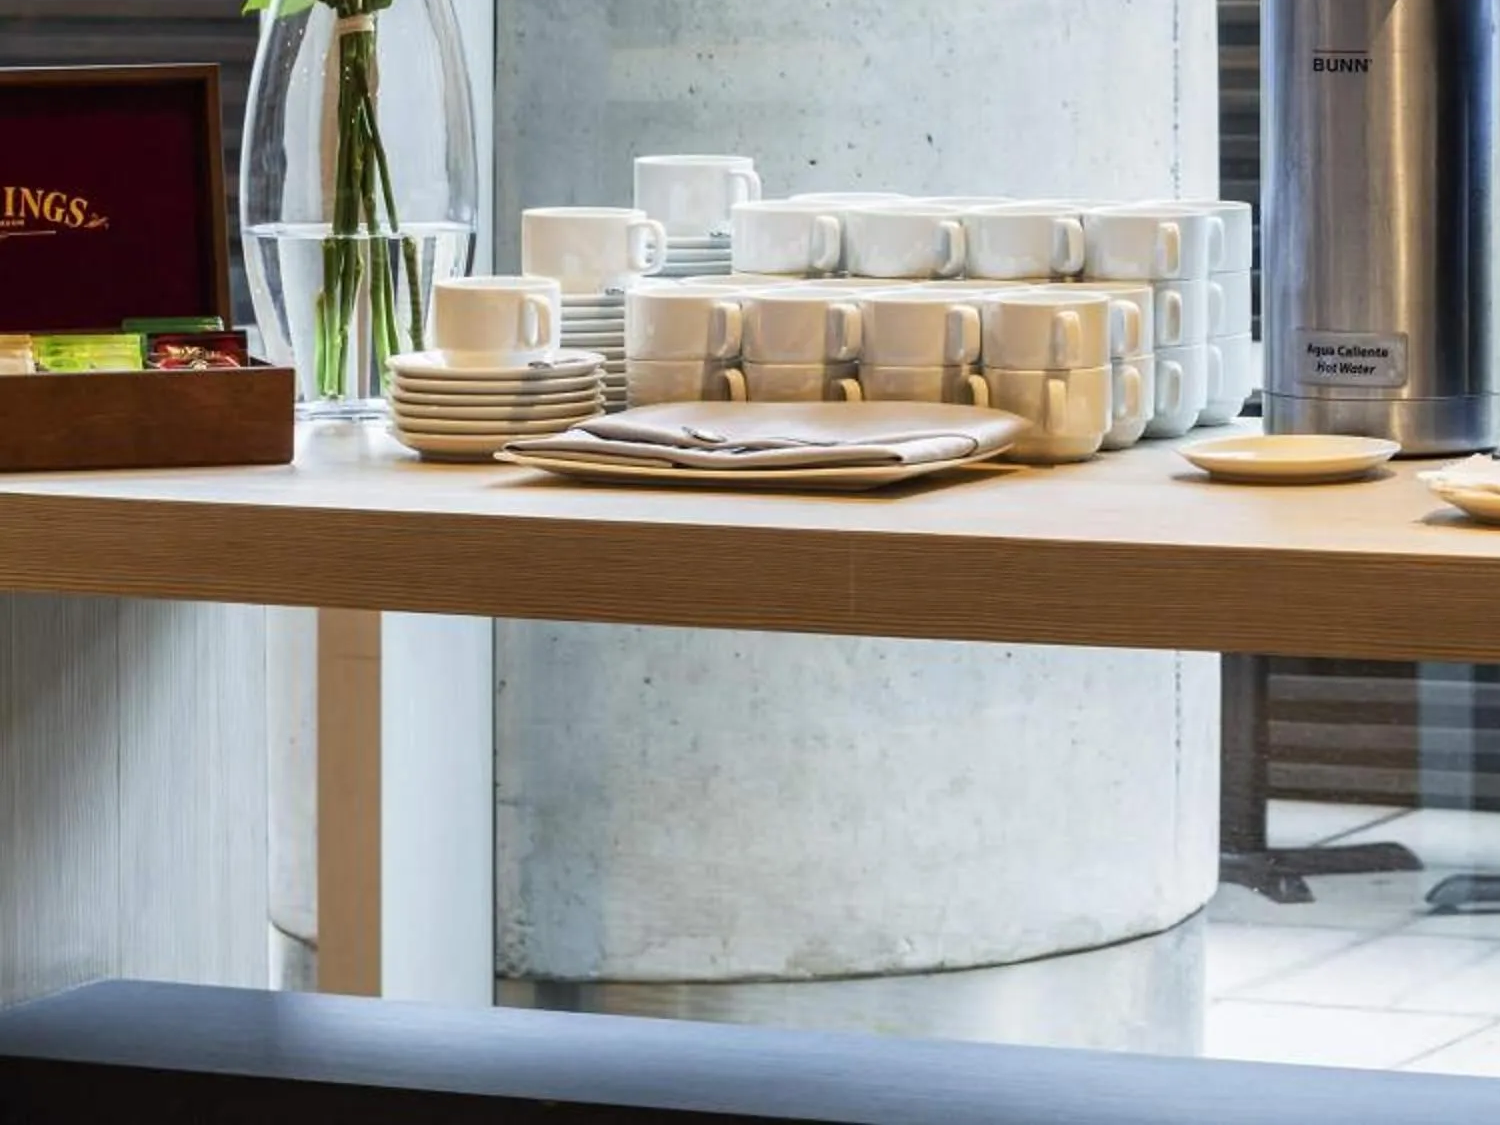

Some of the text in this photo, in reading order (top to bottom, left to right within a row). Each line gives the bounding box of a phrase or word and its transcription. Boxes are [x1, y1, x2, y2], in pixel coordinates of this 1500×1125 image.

[1313, 58, 1369, 73] BUNN
[3, 186, 89, 228] INGS
[1337, 345, 1389, 359] Caliente
[1315, 361, 1377, 376] Hot Water
